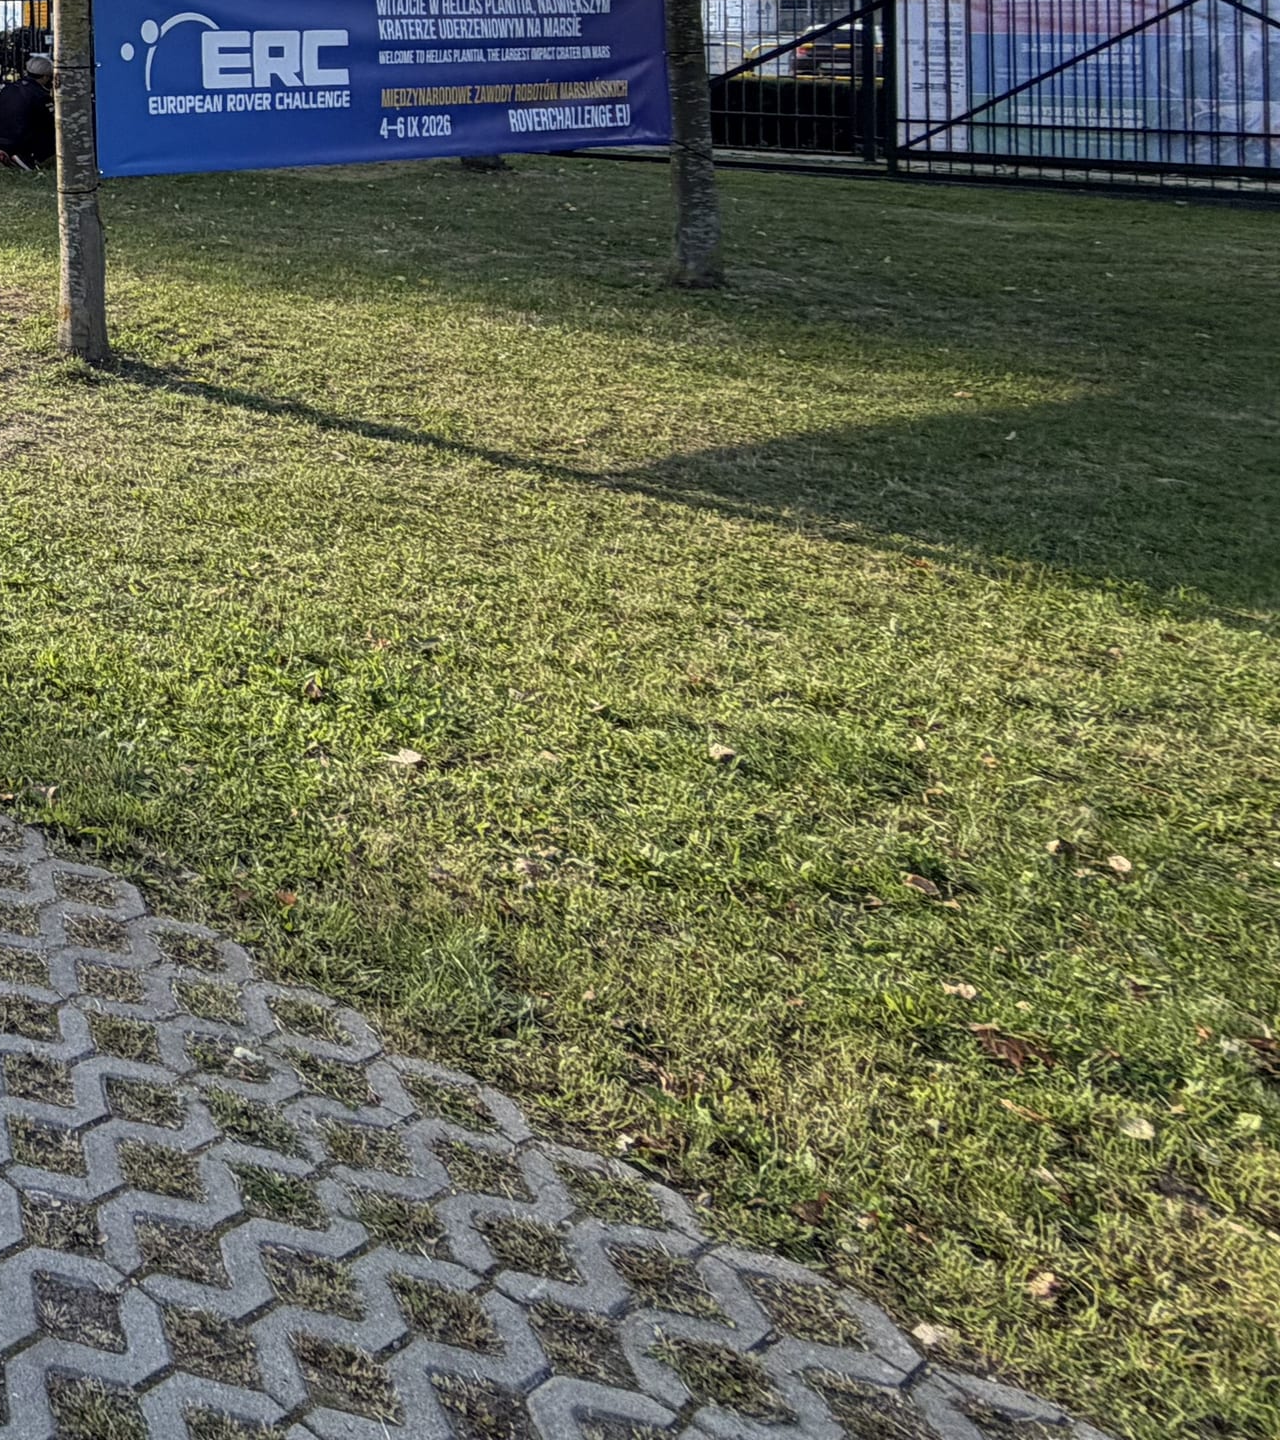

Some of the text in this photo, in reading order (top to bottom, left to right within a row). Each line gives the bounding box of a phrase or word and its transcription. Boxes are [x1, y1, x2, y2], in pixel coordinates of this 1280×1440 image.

[378, 17, 582, 40] KRATERZE UDERZENIOWYM NA MARSIE
[201, 29, 350, 89] ERC
[379, 50, 414, 64] WELCOME
[416, 49, 425, 64] TO
[426, 49, 452, 63] HELLAS
[487, 48, 500, 62] THE
[501, 47, 530, 61] LARGEST
[531, 47, 555, 60] IMPACT
[556, 46, 581, 60] CRATER
[582, 46, 591, 59] ON
[592, 45, 611, 58] MARS
[148, 90, 351, 115] EUROPEAN ROVER CHALLENGE
[381, 76, 628, 110] MIĘDZYNARODOWE ZAWODY ROBOTÓW MARSJAŃSKICH
[407, 116, 420, 137] IX
[422, 114, 452, 137] 2026
[508, 104, 631, 132] ROVERCHALLENGE.EU
